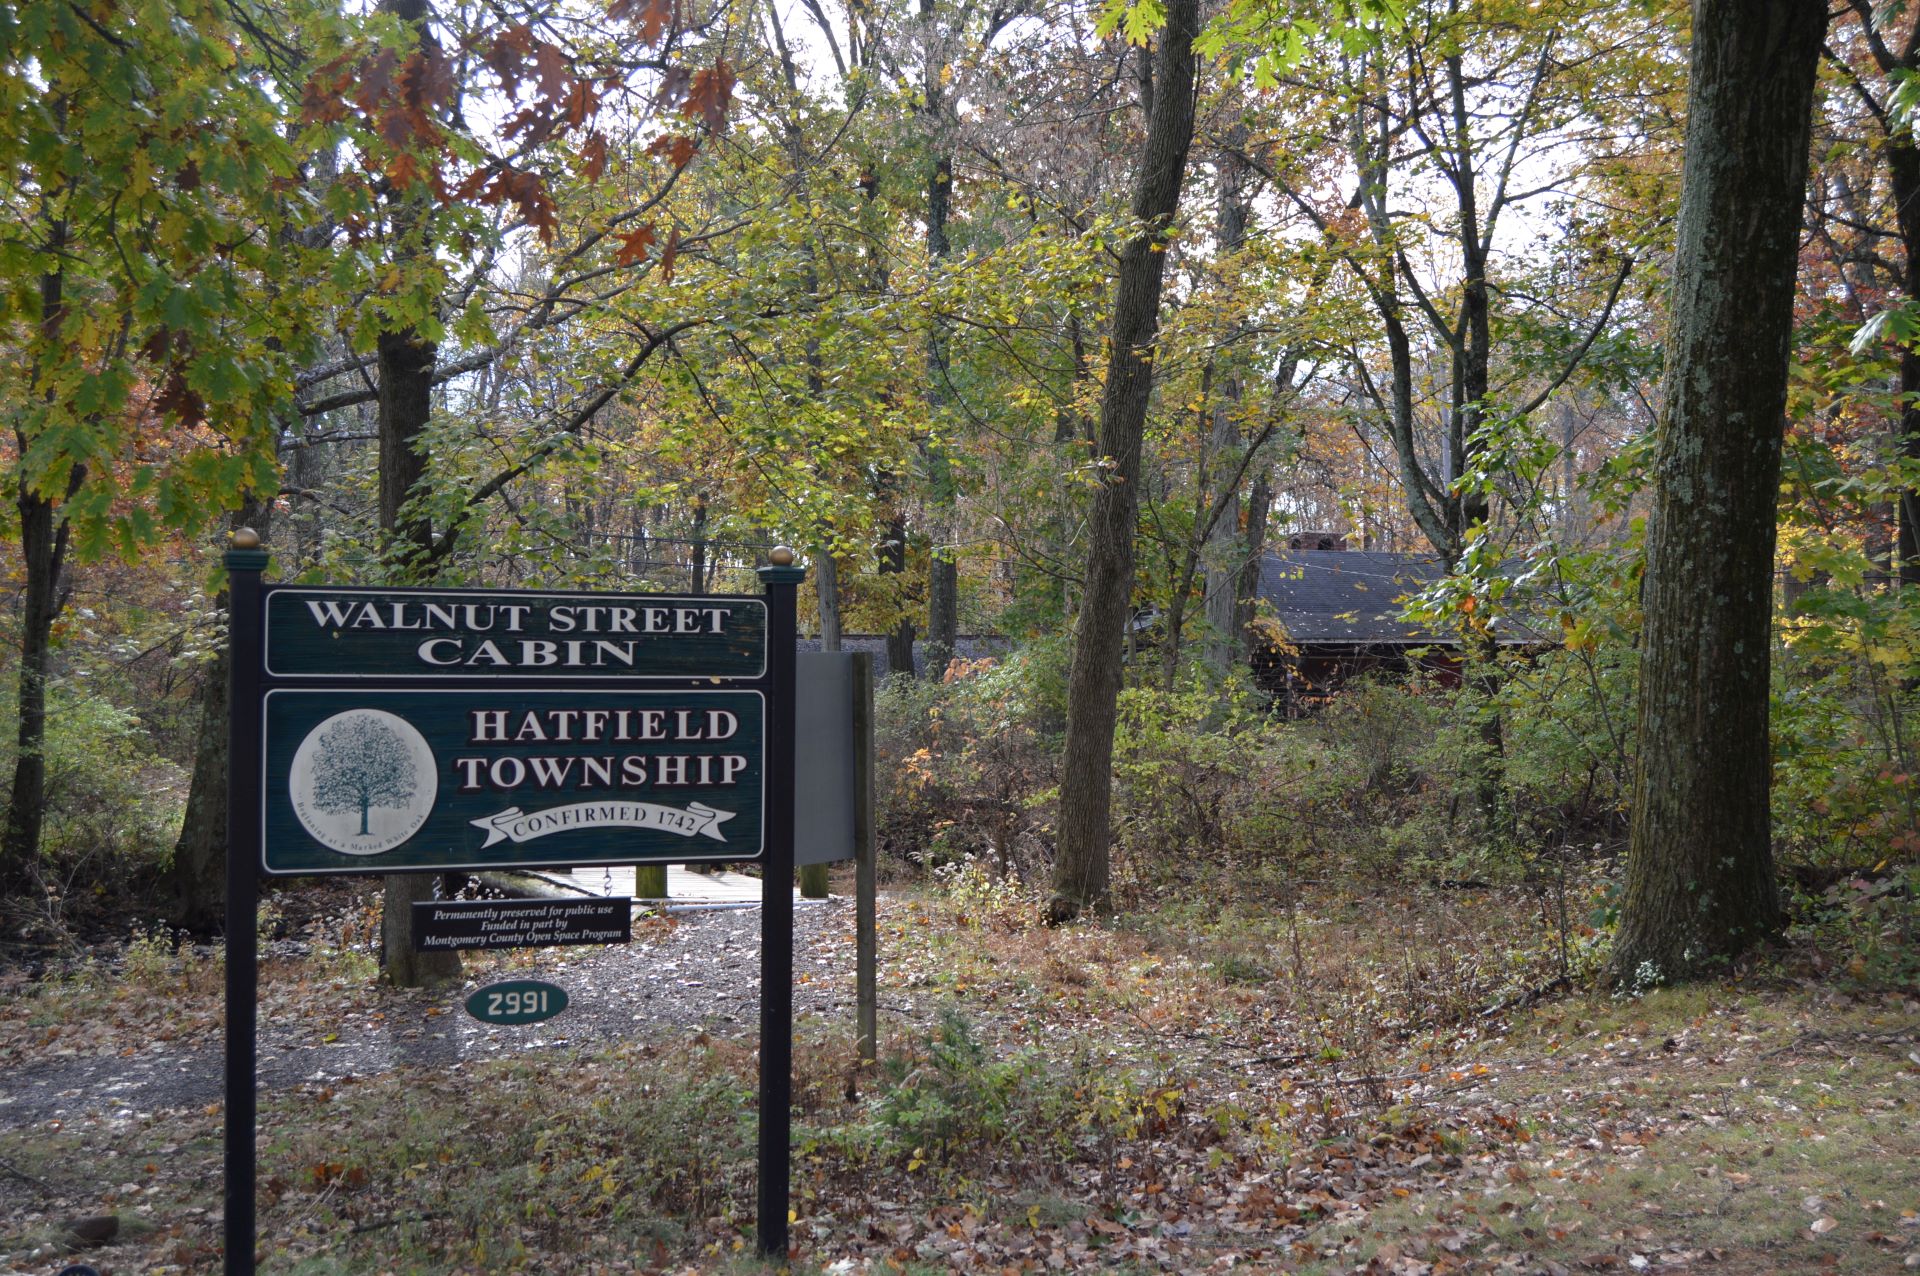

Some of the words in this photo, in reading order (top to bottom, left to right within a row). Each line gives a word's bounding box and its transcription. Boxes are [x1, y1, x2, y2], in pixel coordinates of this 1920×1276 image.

[305, 600, 531, 631] WALNUT
[549, 605, 731, 634] STREET
[417, 638, 639, 666] CABIN
[471, 710, 739, 741] HATFIELD
[456, 755, 748, 789] TOWNSHIP
[513, 806, 647, 837] CONFIRMED
[658, 810, 696, 832] 1742
[433, 908, 498, 921] Permanently
[500, 906, 547, 920] preserved
[547, 905, 564, 919] for
[564, 904, 597, 918] public
[597, 905, 614, 915] use
[480, 920, 518, 931] Funded
[519, 919, 530, 930] in
[532, 919, 554, 932] part
[555, 918, 568, 931] by
[423, 935, 488, 948] Montgomery
[489, 932, 524, 945] County
[526, 931, 551, 944] Open
[553, 930, 580, 943] Space
[581, 929, 622, 942] Program
[487, 990, 548, 1016] 2991
